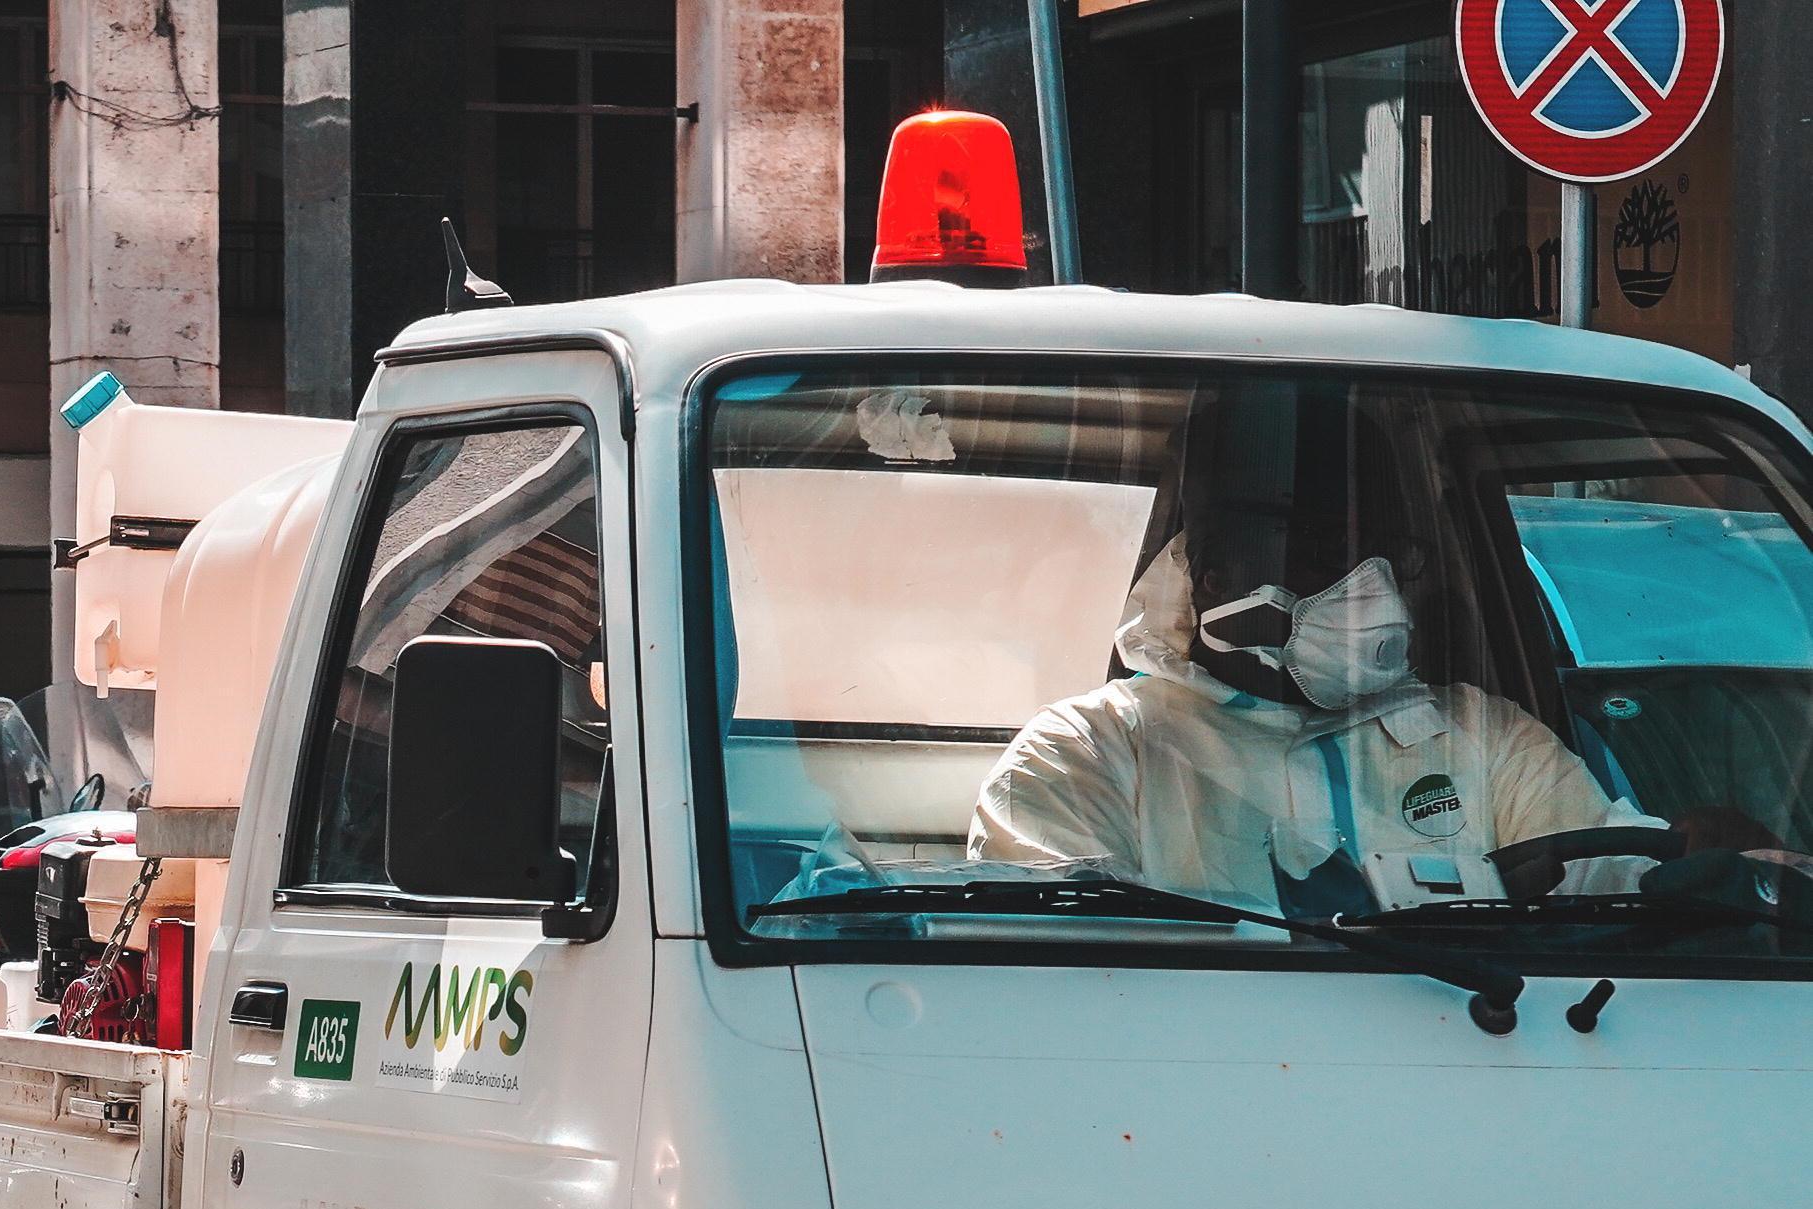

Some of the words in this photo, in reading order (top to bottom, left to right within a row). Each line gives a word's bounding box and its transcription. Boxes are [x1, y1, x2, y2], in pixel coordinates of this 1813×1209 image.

[304, 1016, 349, 1064] A835
[379, 1060, 403, 1077] Azienda
[447, 1067, 474, 1084] Pubblico
[474, 1071, 500, 1087] Servizio
